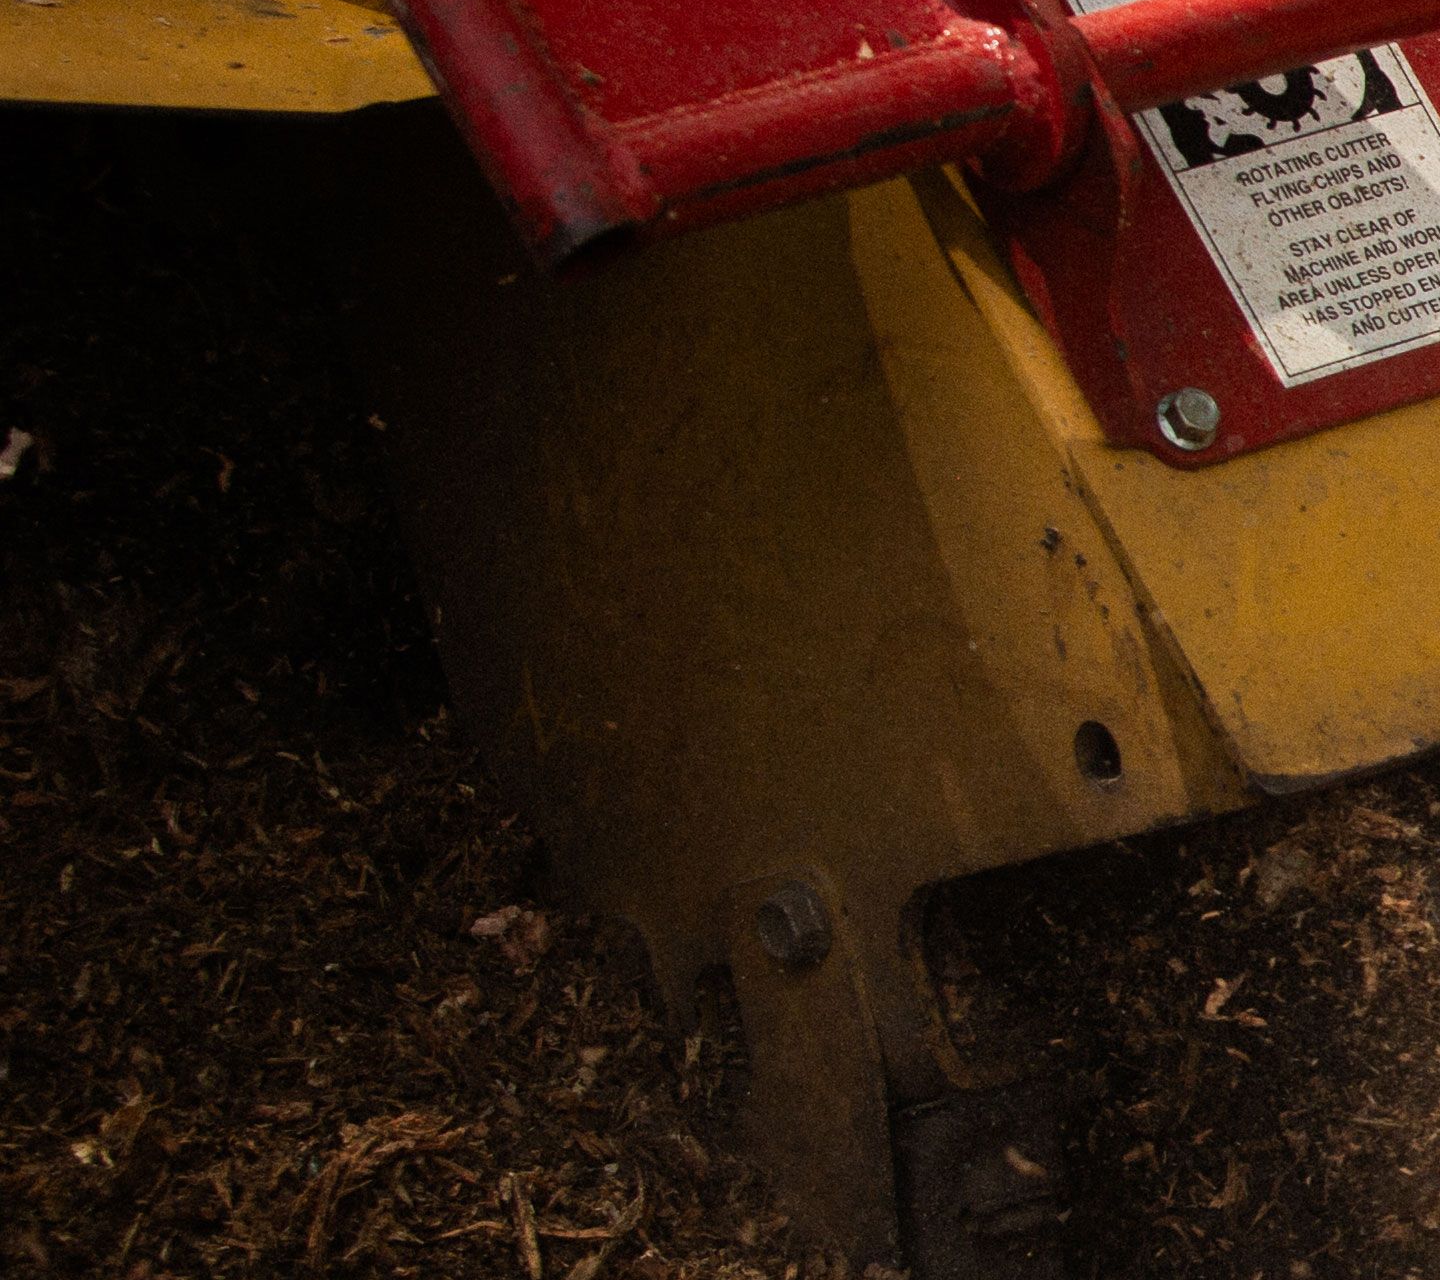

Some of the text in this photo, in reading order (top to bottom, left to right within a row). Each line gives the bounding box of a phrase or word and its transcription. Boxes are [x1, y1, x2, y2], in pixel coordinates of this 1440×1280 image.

[1238, 132, 1392, 187] ROTATING CUTTER
[1251, 153, 1401, 208] FLYING CHIPS AND
[1268, 175, 1410, 227] OTHER OBJECTS!
[1289, 208, 1416, 257] STAY CLEAR OF
[1283, 250, 1361, 284] MACHINE
[1364, 239, 1398, 261] AND
[1278, 286, 1325, 311] AREA
[1324, 265, 1391, 296] UNLESS
[1302, 305, 1339, 326] HAS
[1338, 282, 1416, 316] STOPPED
[1351, 315, 1386, 337] AND
